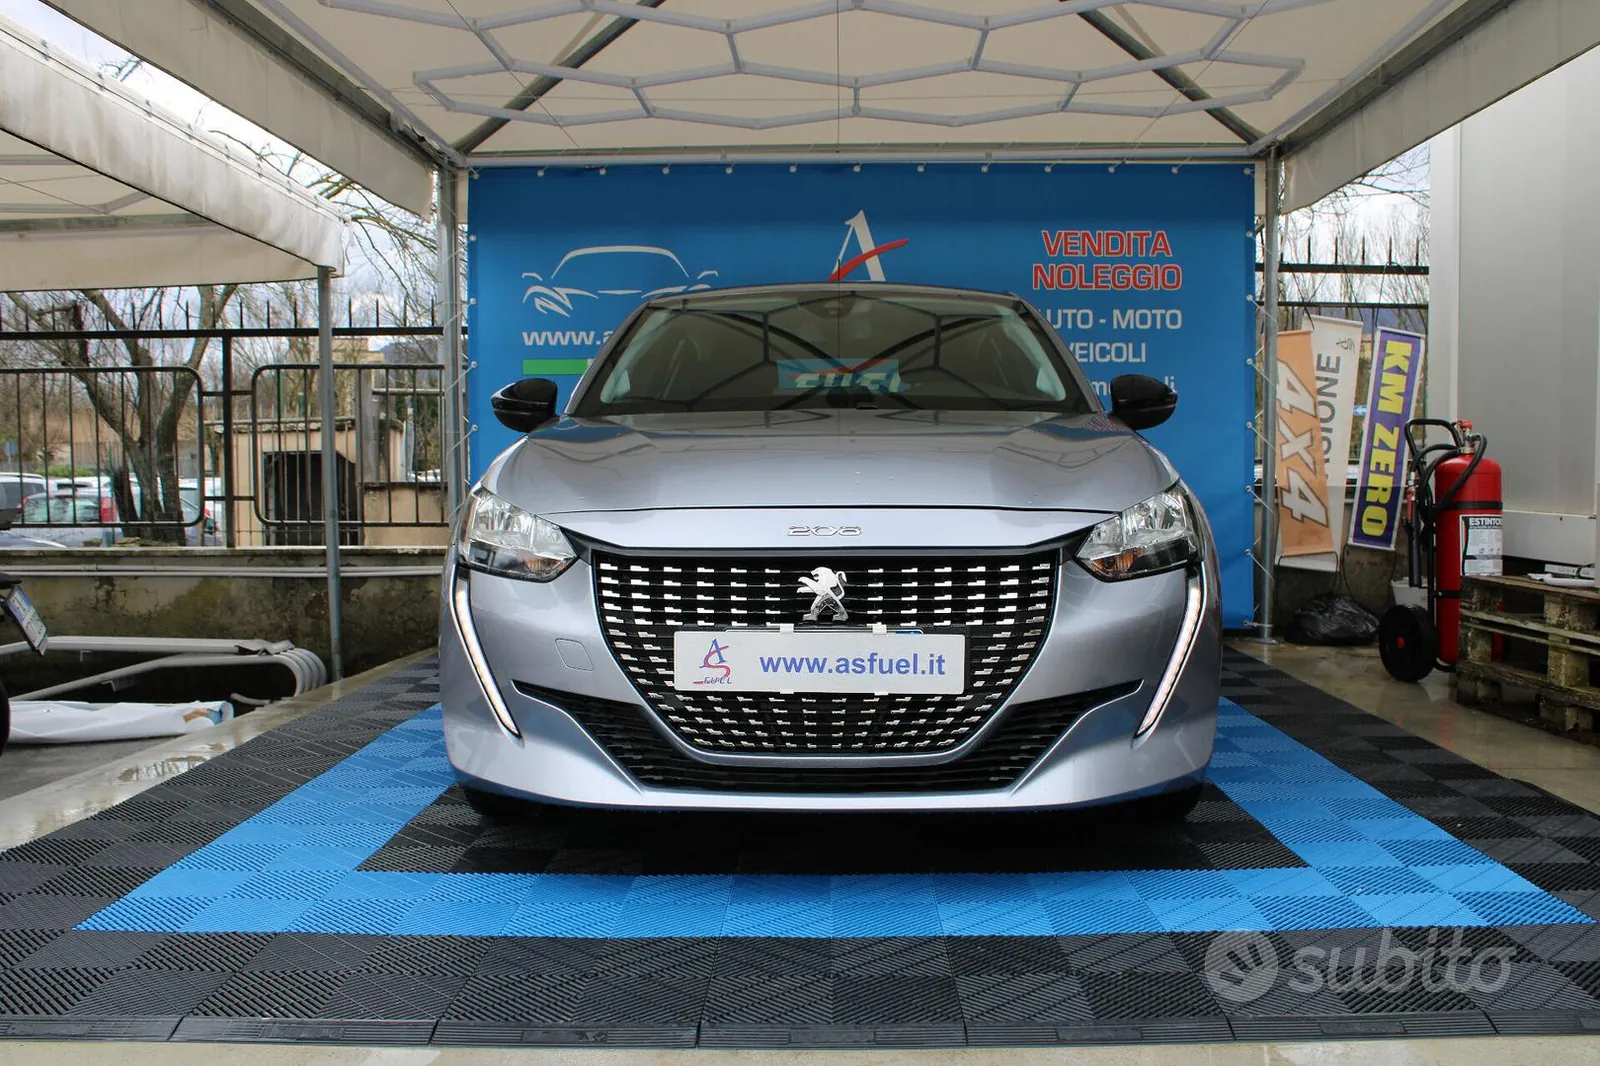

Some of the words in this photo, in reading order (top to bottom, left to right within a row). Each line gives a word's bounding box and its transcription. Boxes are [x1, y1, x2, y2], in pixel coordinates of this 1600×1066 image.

[1041, 230, 1173, 257] VENDITA
[1032, 263, 1183, 291] NOLEGGIO
[1042, 309, 1093, 329] UTO
[1112, 309, 1182, 329] MOTO
[1377, 340, 1412, 414] KM
[1361, 426, 1400, 537] ZERO
[788, 525, 861, 537] 208
[1469, 517, 1502, 526] ESTINTO
[760, 653, 946, 675] www.asfuel.it
